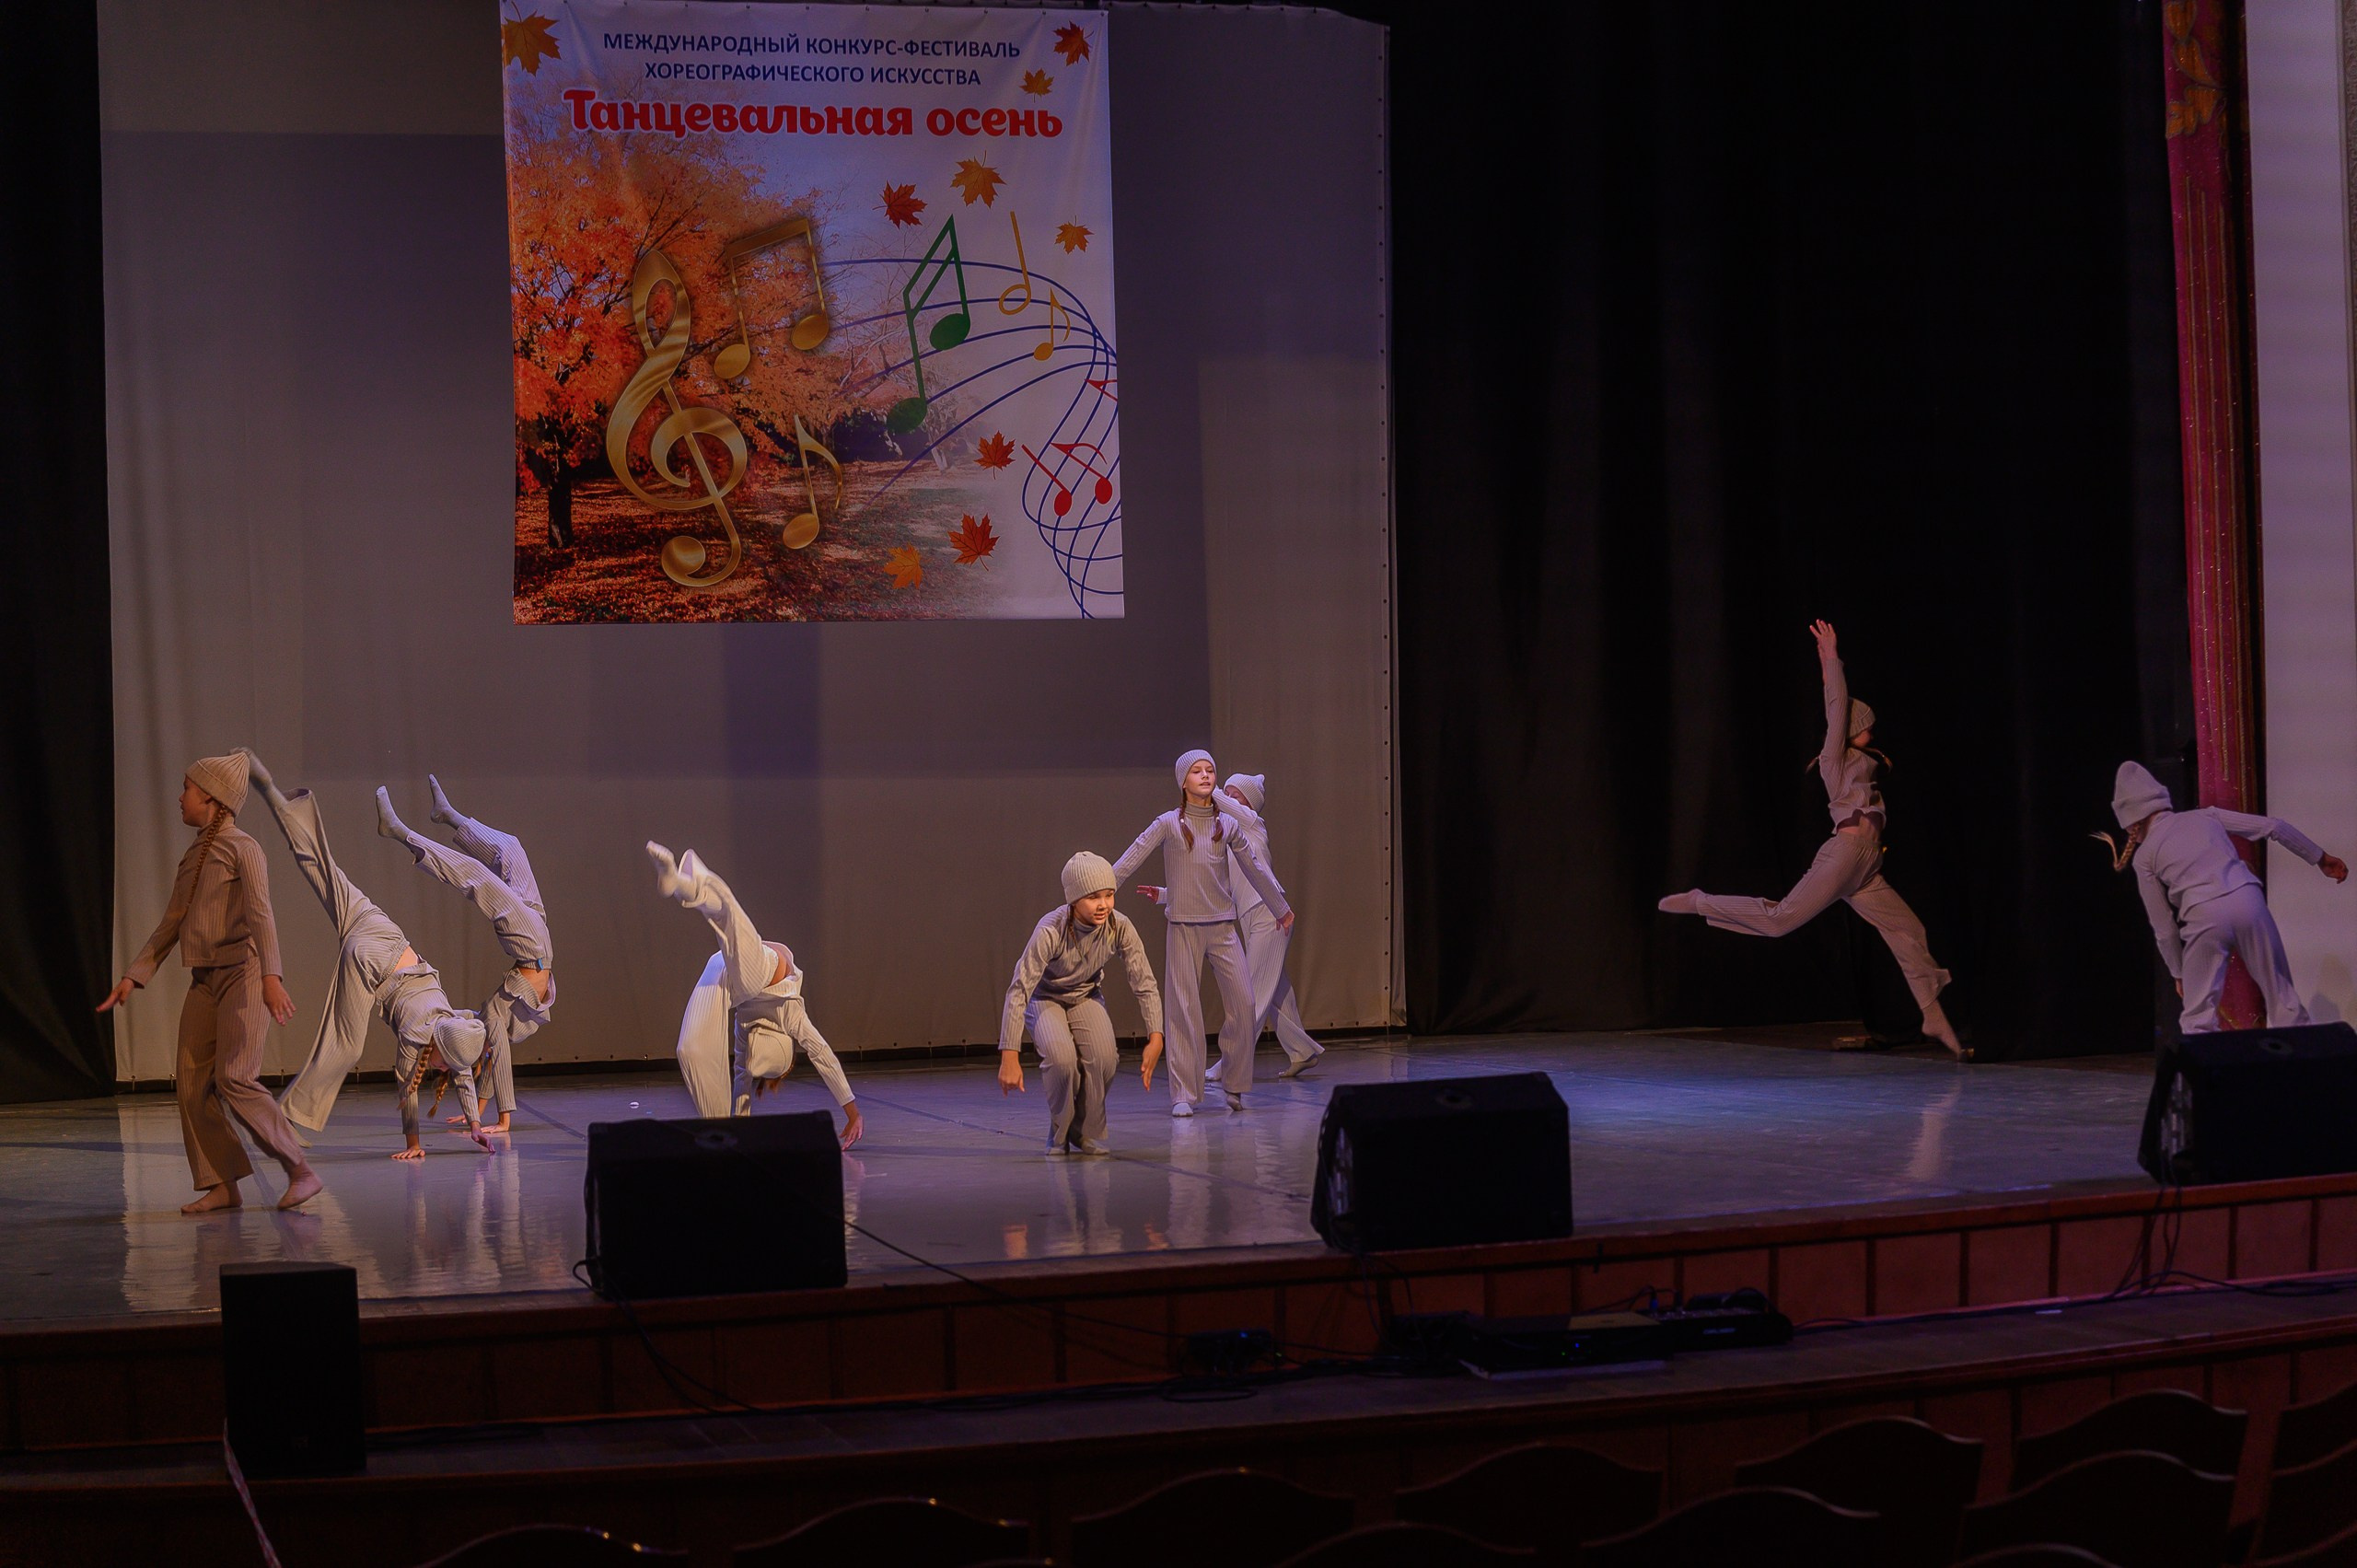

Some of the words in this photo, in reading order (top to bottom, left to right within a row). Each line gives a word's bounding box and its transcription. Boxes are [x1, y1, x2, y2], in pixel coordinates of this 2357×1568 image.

[603, 33, 800, 55] МЕЖДУНАРОДНЫЙ
[806, 38, 1020, 58] КОНКУРС-ФЕСТИВАЛЬ
[644, 62, 864, 83] ХОРЕОГРАФИЧЕСКОГО
[870, 67, 981, 86] ИСКУССТВА
[563, 89, 912, 138] Танцевальная
[926, 107, 1063, 137] осень
